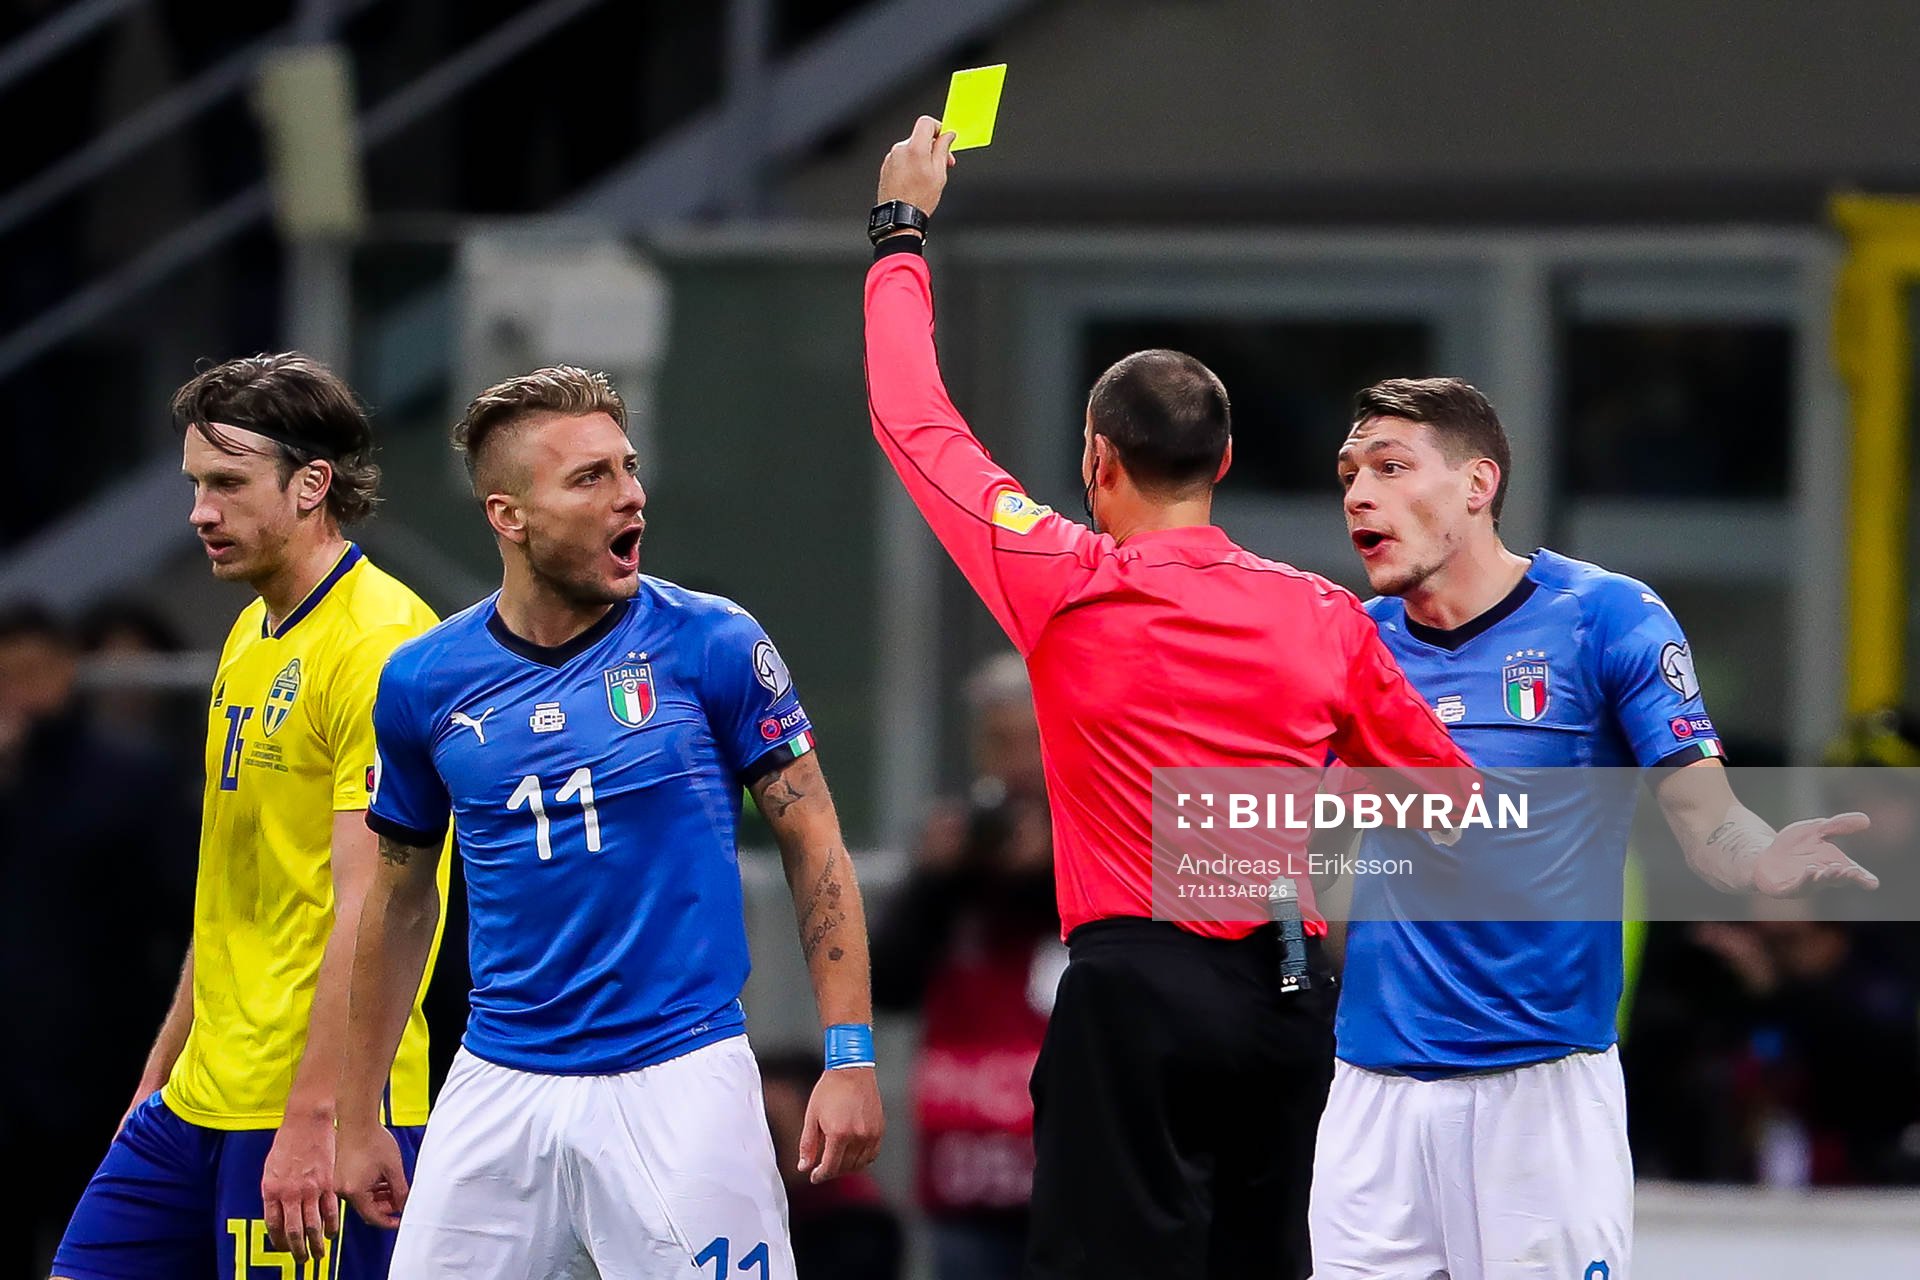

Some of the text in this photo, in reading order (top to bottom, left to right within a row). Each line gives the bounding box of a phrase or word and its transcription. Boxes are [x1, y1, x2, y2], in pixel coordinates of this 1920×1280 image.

[609, 668, 648, 683] ITALIA
[1507, 666, 1544, 679] ITALIA
[1690, 719, 1714, 731] RES
[507, 768, 601, 860] 11
